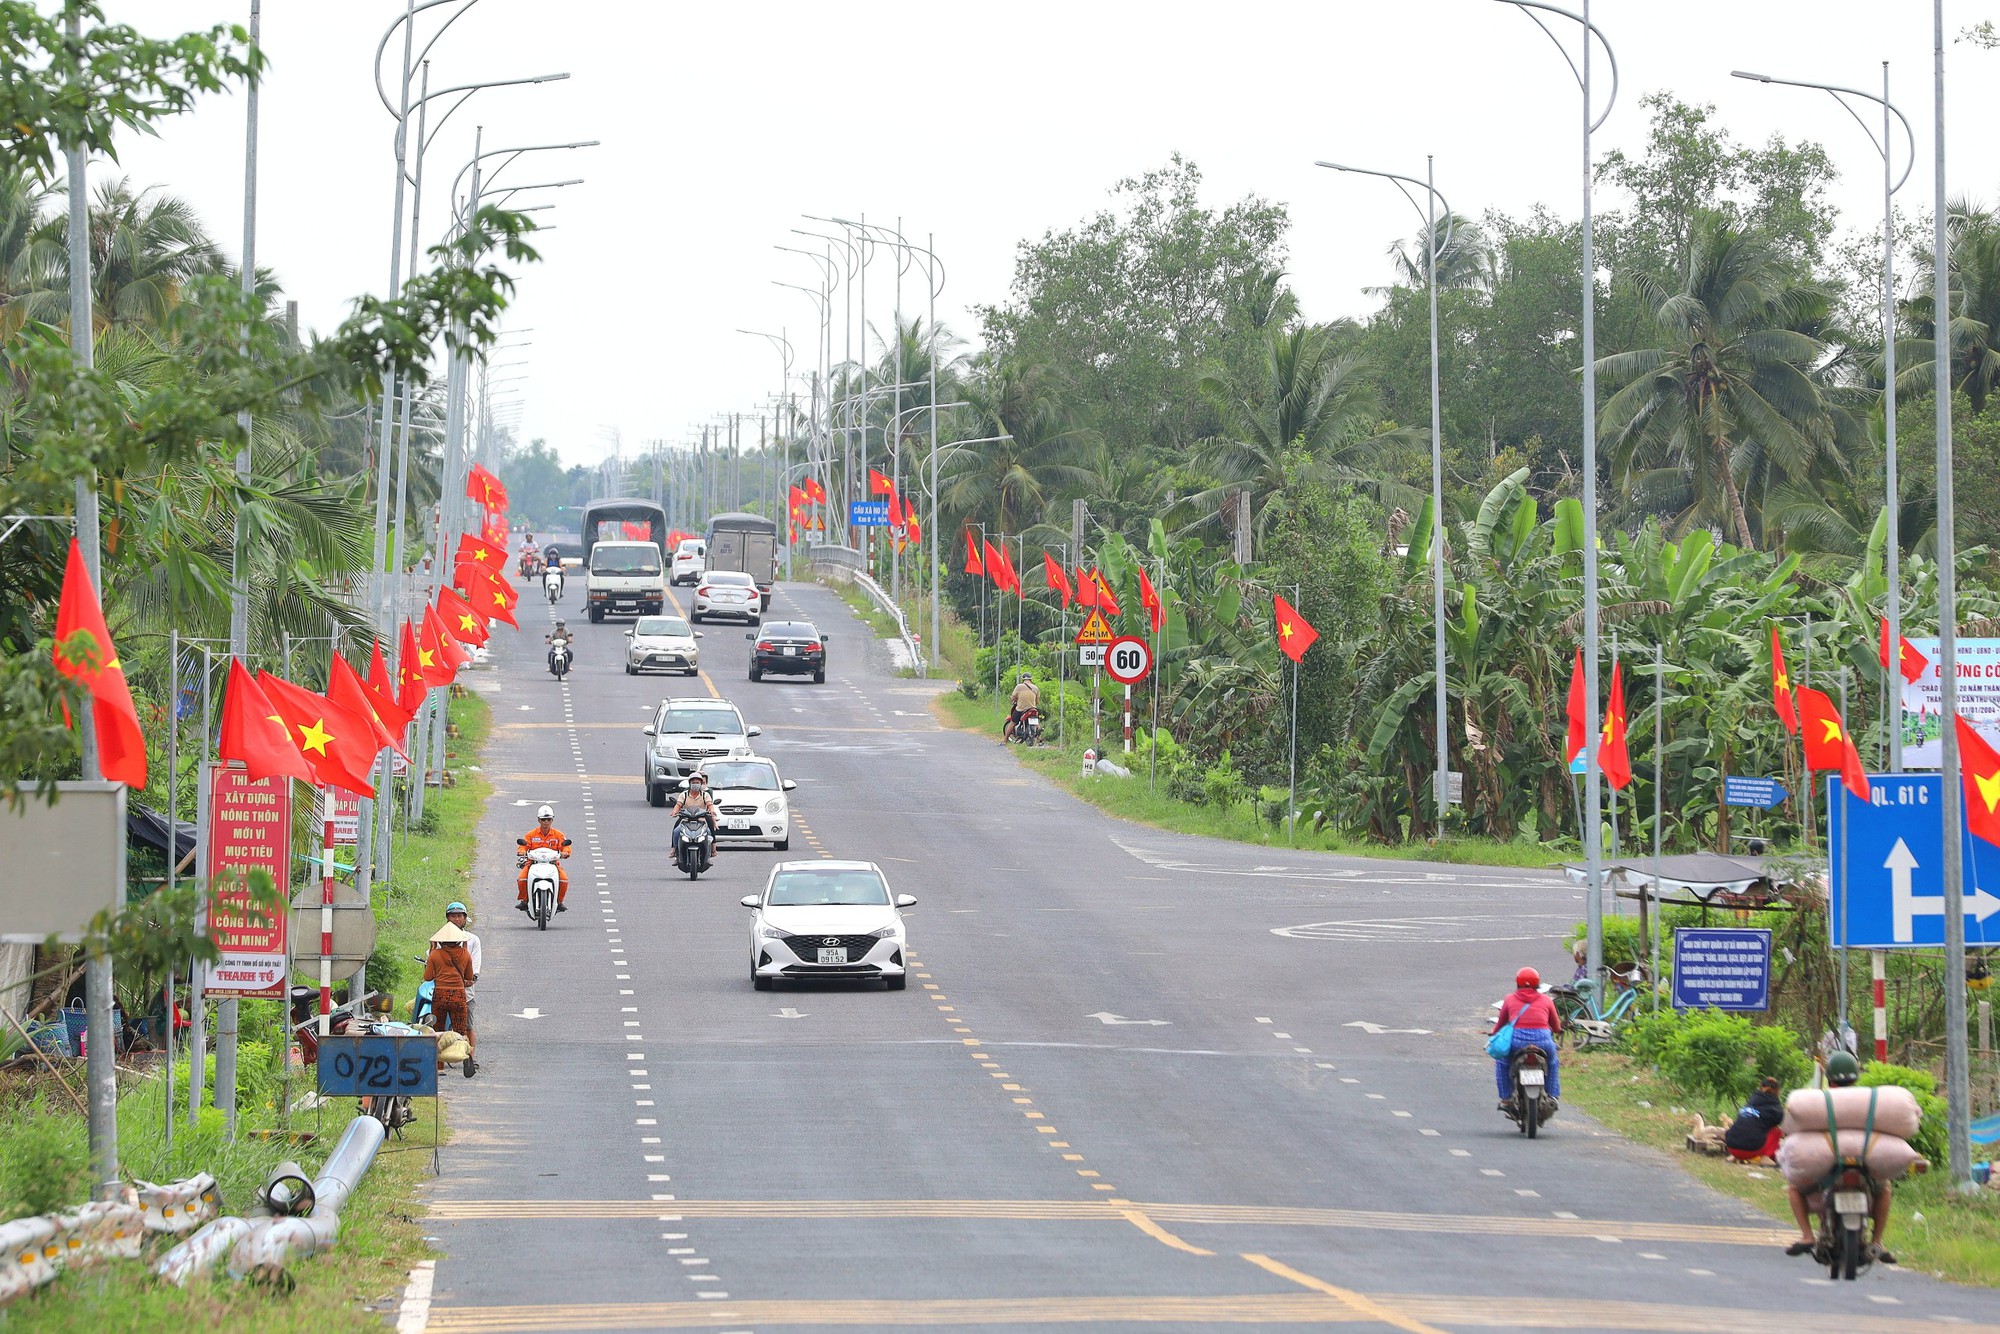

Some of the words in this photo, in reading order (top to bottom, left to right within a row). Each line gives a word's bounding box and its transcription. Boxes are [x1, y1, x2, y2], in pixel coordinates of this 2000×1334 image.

[1086, 650, 1096, 660] 50
[1116, 650, 1140, 670] 60
[1935, 661, 1982, 678] ĐỜNG
[232, 774, 248, 786] THI
[250, 776, 270, 786] UA
[224, 790, 245, 804] XÂY
[247, 792, 276, 806] DỰNG
[1871, 785, 1894, 807] QL.
[1898, 785, 1914, 805] 61
[1918, 785, 1928, 805] C
[220, 808, 250, 822] NÔNG
[252, 810, 279, 822] THÔN
[233, 826, 253, 840] MỚI
[256, 826, 266, 840] VÌ
[224, 846, 248, 860] MỤC
[250, 844, 273, 858] TIÊU
[216, 914, 244, 928] CÔNG
[216, 970, 256, 982] THANH
[258, 970, 274, 982] TÚ
[334, 1052, 422, 1088] 0725
